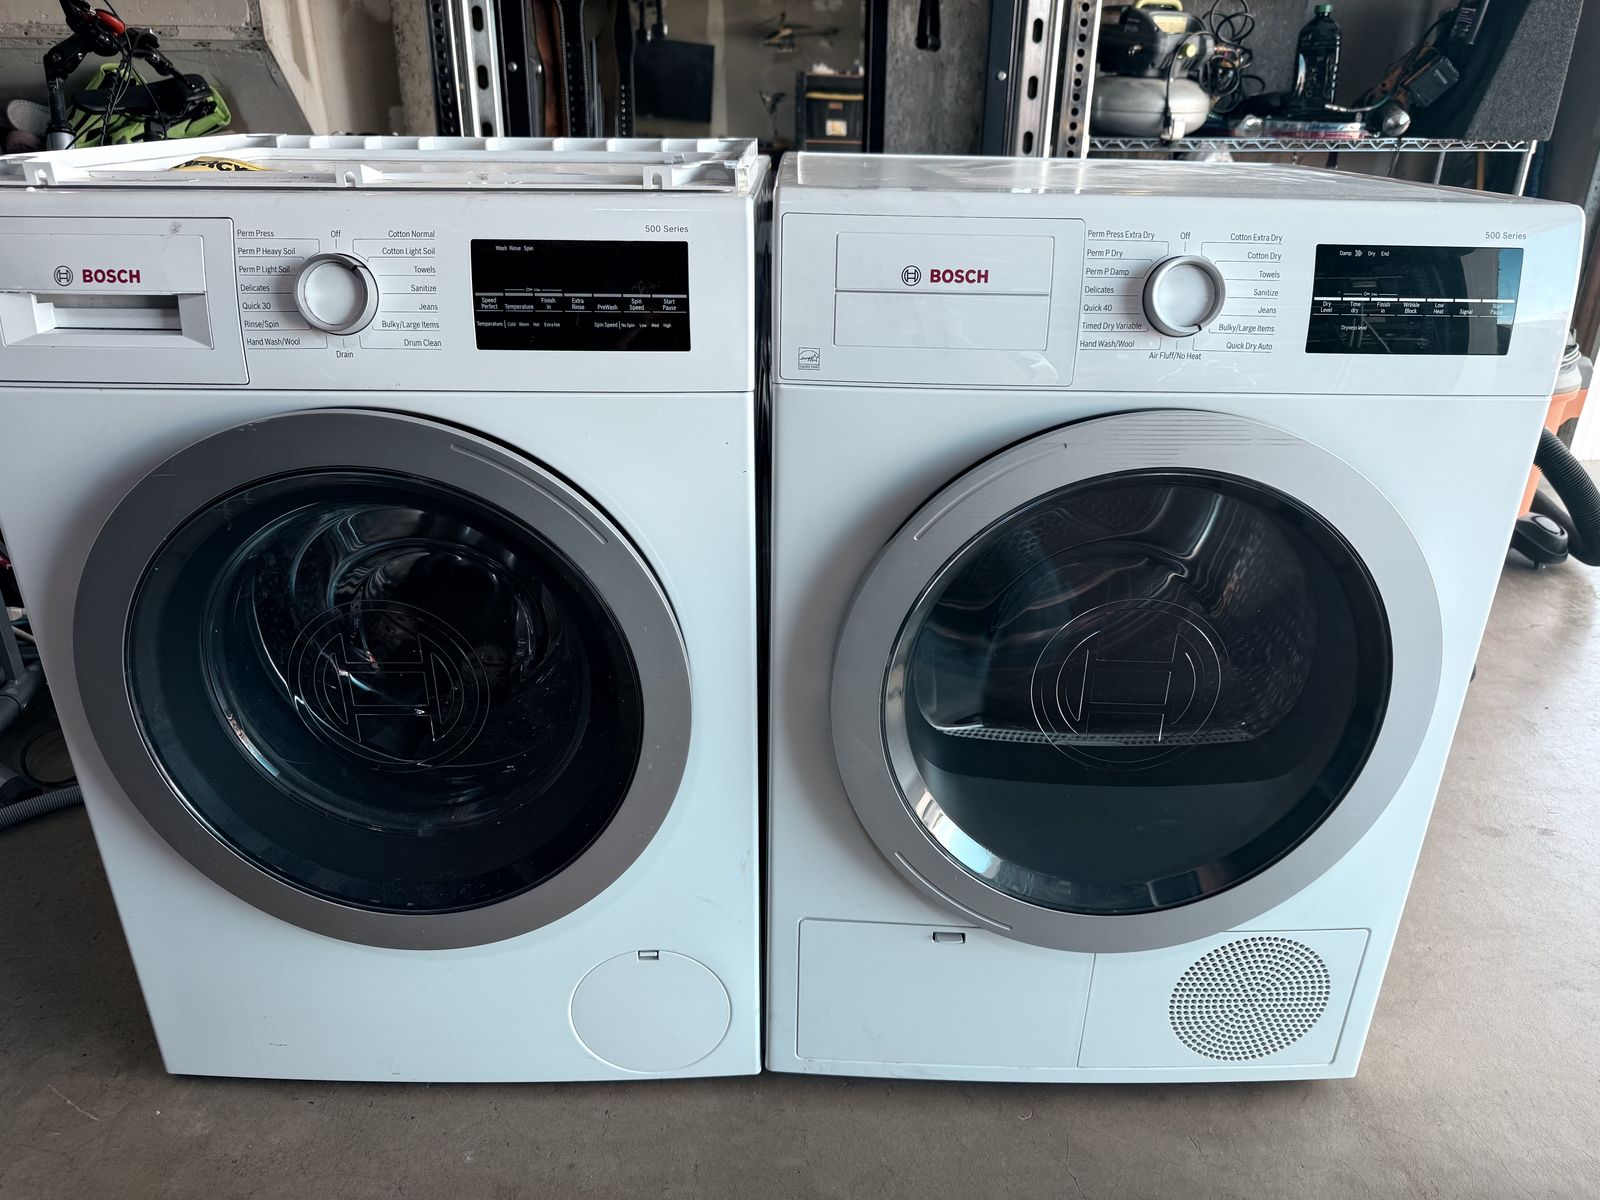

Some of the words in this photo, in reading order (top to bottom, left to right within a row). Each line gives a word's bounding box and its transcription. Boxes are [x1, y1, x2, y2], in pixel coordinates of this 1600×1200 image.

[1143, 231, 1155, 240] Dry
[1271, 234, 1282, 243] Dry
[262, 248, 281, 256] Heavy
[1111, 250, 1123, 258] Dry
[1270, 253, 1281, 261] Dry
[82, 269, 141, 283] BOSCH
[930, 269, 989, 283] BOSCH
[1110, 268, 1129, 277] Damp
[382, 321, 420, 329] Bulky/Large
[1103, 322, 1114, 331] Dry
[1219, 324, 1256, 333] Bulky/Large
[1227, 342, 1244, 350] Quick
[1246, 342, 1257, 352] Dry
[336, 350, 354, 358] Drain
[1160, 352, 1186, 360] Fluff/No
